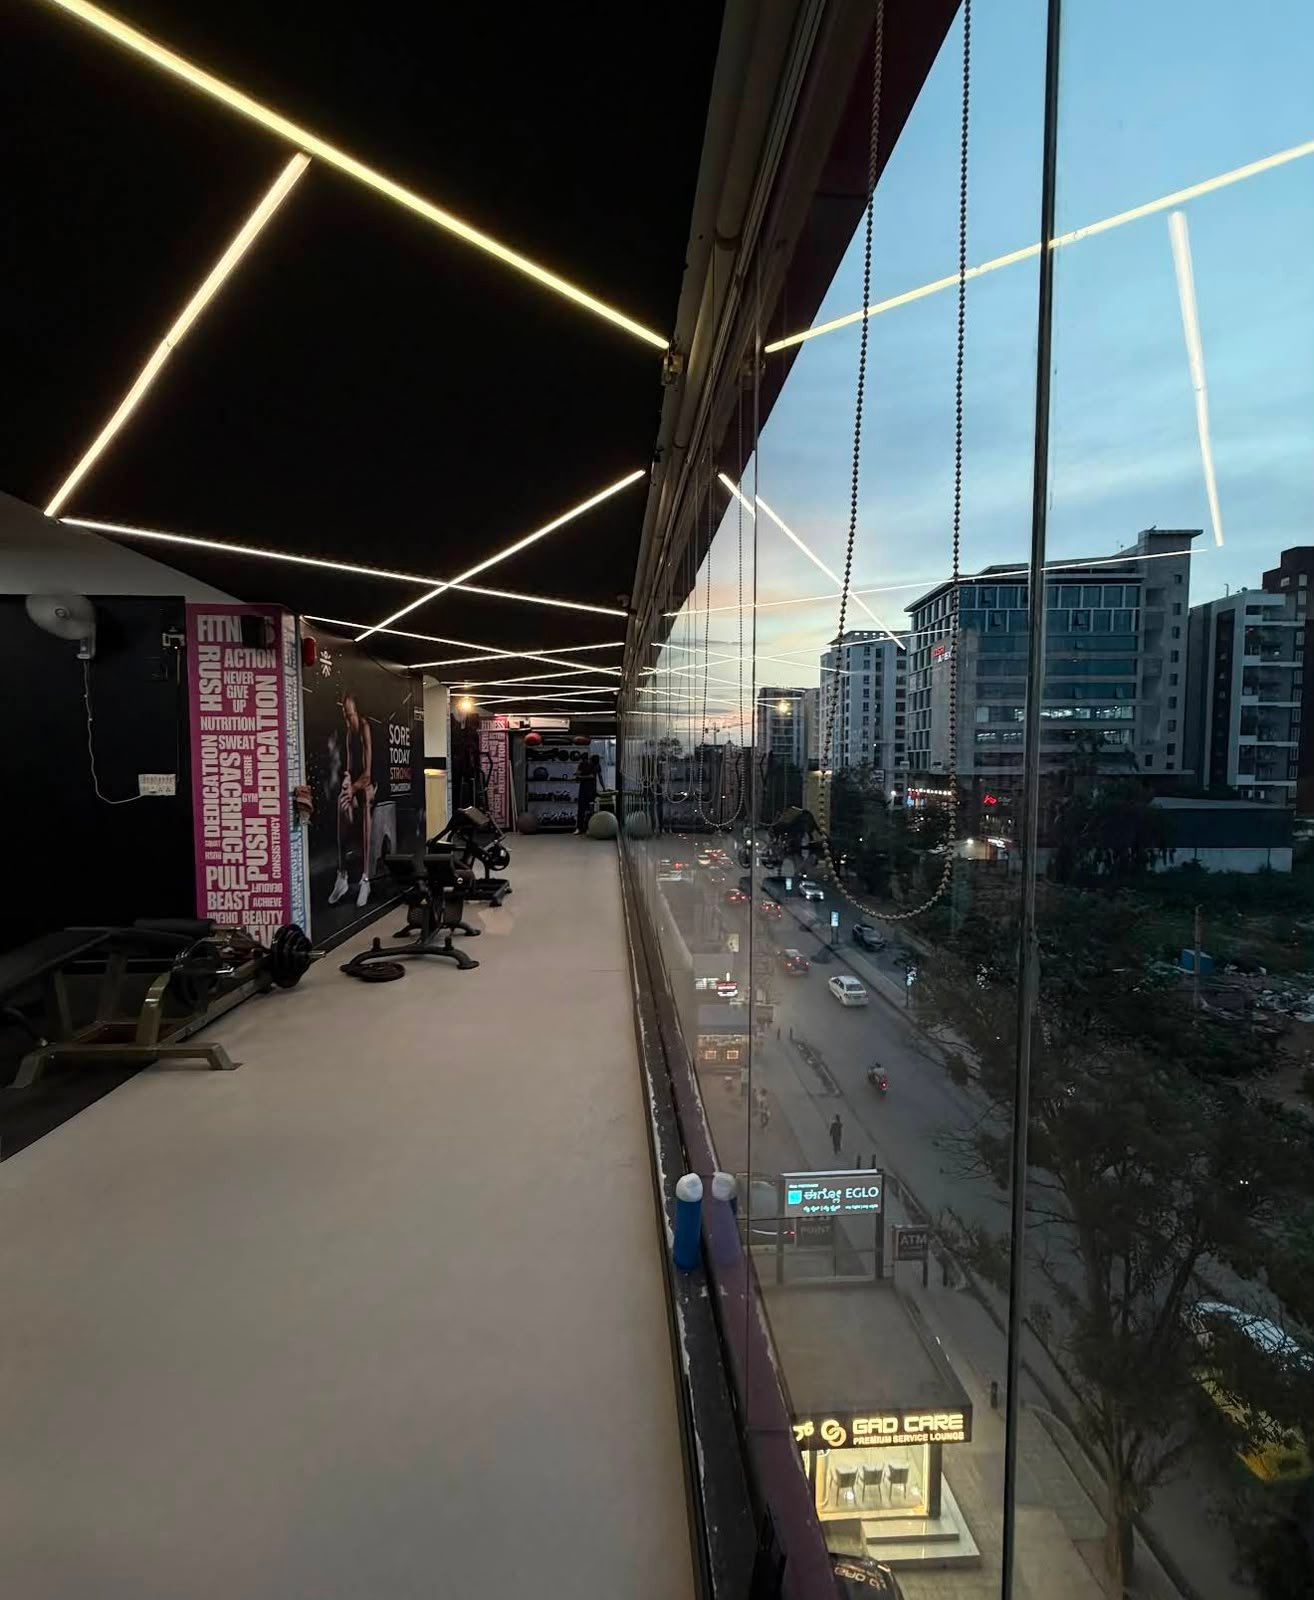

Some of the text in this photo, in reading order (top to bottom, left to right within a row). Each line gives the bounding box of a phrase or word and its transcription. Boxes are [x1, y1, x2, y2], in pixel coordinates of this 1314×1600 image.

[223, 648, 277, 669] ACTION
[198, 645, 223, 711] RUSH
[223, 671, 255, 685] NEVER
[226, 685, 250, 699] GIVE
[232, 699, 247, 713] UP
[200, 716, 256, 732] NUTRITION
[218, 735, 256, 750] SWEAT
[388, 723, 411, 747] SORE
[255, 675, 281, 815] DEDICATION
[389, 747, 411, 765] TODAY
[243, 755, 254, 786] DESIRE
[201, 734, 221, 838] DEDICATION
[242, 792, 259, 803] GYM
[219, 752, 244, 864] SACRIFICE
[245, 817, 269, 882] PUSH
[270, 817, 282, 879] CONSISTENCY
[205, 866, 249, 891] PULL
[252, 882, 284, 894] DEADLIFT
[207, 891, 251, 911] BEAST
[252, 897, 283, 908] ACHIEVE
[242, 910, 284, 925] BEAUTY
[845, 1186, 880, 1199] EGLO
[901, 1234, 928, 1247] ATM
[852, 1414, 964, 1435] GAD CARE
[852, 1431, 965, 1446] PREMIUM SERVICE LOUNGE
